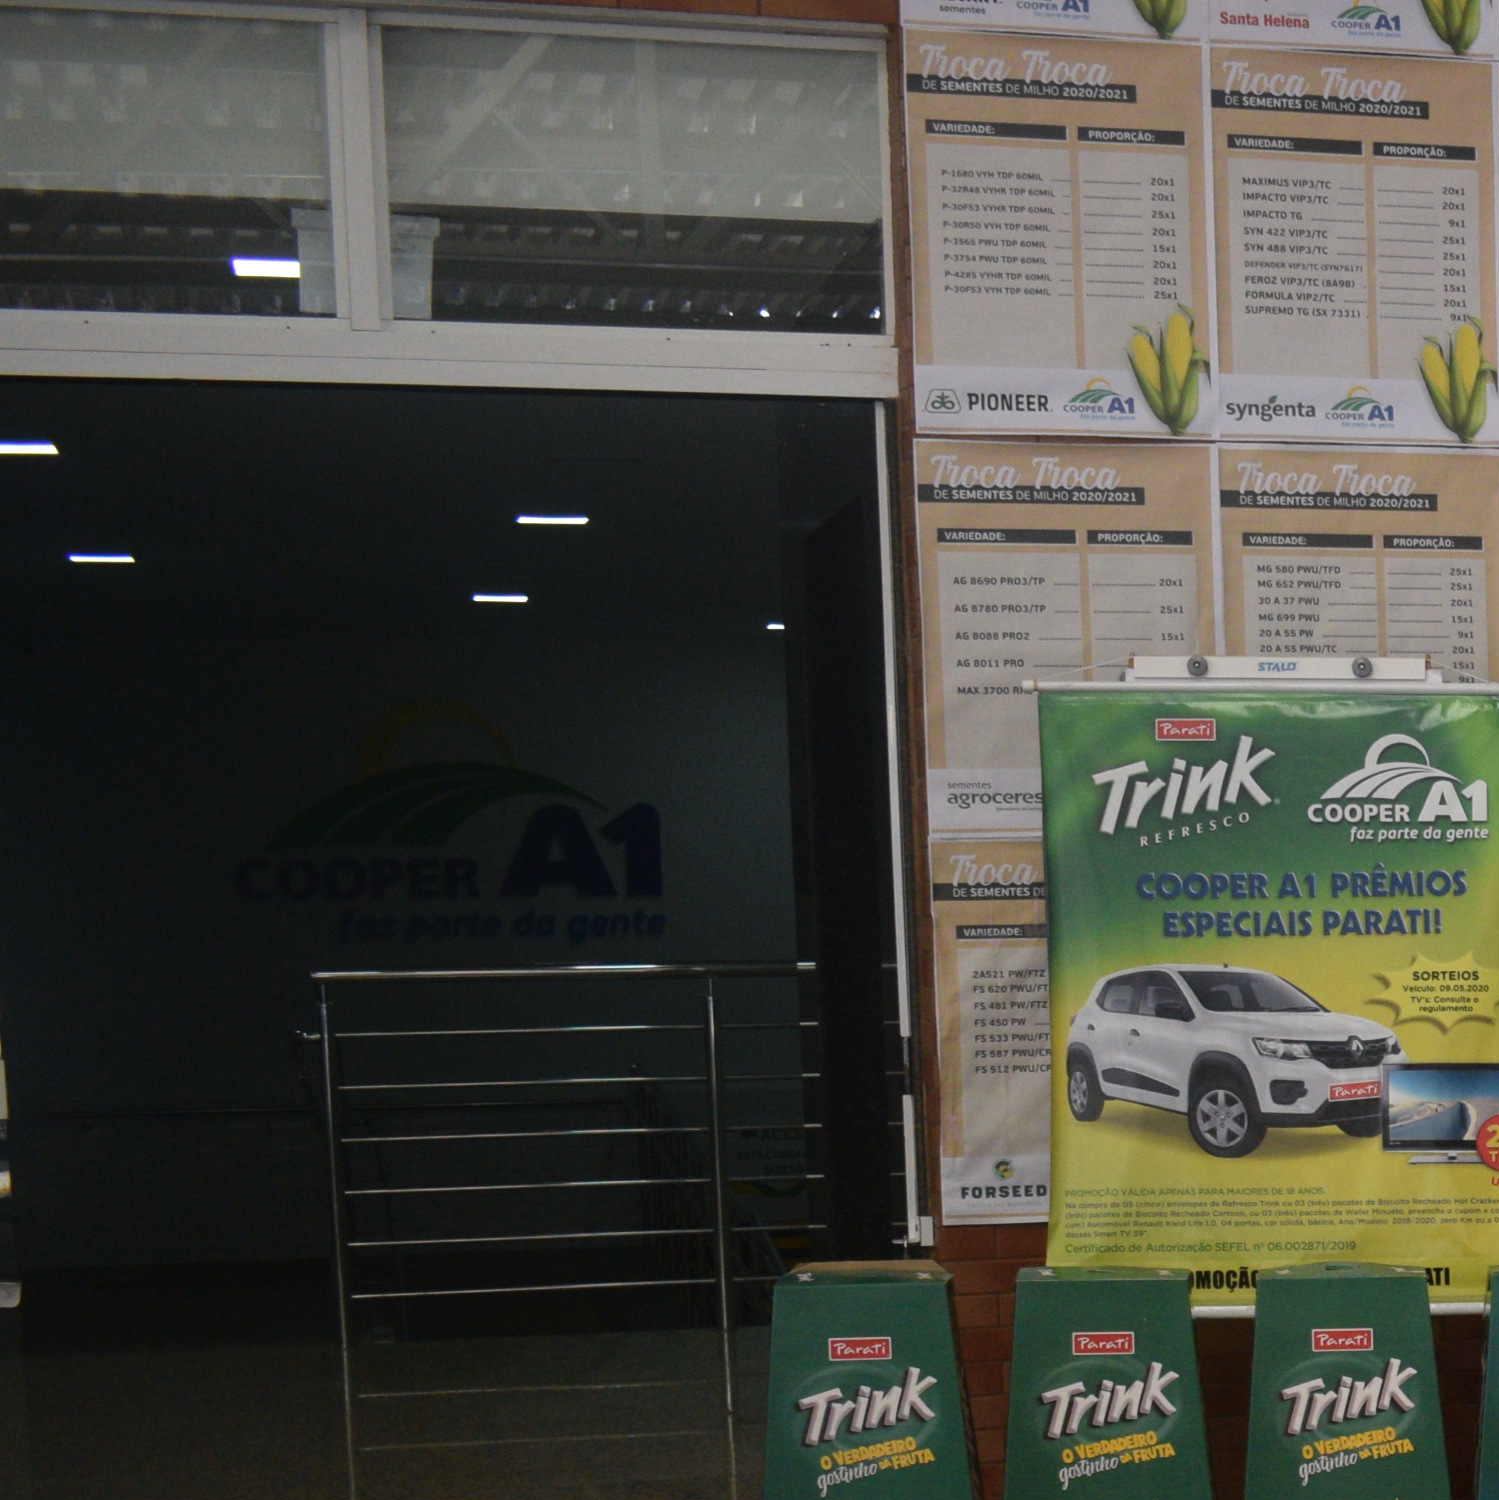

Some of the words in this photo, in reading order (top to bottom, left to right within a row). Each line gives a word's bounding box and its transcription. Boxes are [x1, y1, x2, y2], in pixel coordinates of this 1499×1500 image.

[1220, 11, 1259, 26] Santa
[1264, 14, 1309, 29] Helena
[919, 44, 1011, 81] Troca
[1022, 49, 1112, 86] Troca
[922, 80, 937, 90] DE
[940, 81, 1003, 93] SEMENTES
[1005, 84, 1020, 94] DE
[1023, 85, 1060, 96] MILHO
[1062, 87, 1128, 100] 2020/2021
[1222, 61, 1309, 97] Troca
[1321, 67, 1407, 103] Troca
[932, 123, 995, 135] VARIEDADE:
[1088, 130, 1155, 143] PROPORÇÃO:
[1243, 178, 1290, 187] MAXIMUS
[1292, 179, 1331, 190] VIP3/TC
[967, 393, 1049, 412] PIONEER
[1226, 395, 1316, 422] syngenta
[1257, 566, 1272, 574] MG
[1275, 566, 1294, 574] 580
[1297, 566, 1341, 575] PWU/TFD
[1450, 568, 1473, 576] 25x1
[971, 577, 997, 585] 8690
[1000, 577, 1045, 586] PRO3/TP
[1159, 579, 1183, 587] 20x1
[1160, 723, 1211, 736] Parati
[1092, 735, 1276, 835] Trink
[1308, 804, 1410, 822] COOPER
[1418, 780, 1487, 822] A1
[1140, 812, 1250, 847] REFRESCO
[1350, 827, 1373, 842] faz
[1378, 827, 1418, 842] parte
[1423, 827, 1441, 839] da
[1447, 827, 1489, 842] gente
[235, 857, 481, 900] COOPER
[500, 803, 663, 897] A1
[1137, 872, 1269, 899] COOPER
[1278, 872, 1317, 898] A1
[1332, 862, 1467, 898] PRÊMIOS
[1163, 910, 1312, 938] ESPECIAIS
[1323, 908, 1442, 936] PARATI!
[1413, 971, 1479, 981] SORTEIOS
[1419, 1005, 1473, 1013] regulamento
[1434, 996, 1472, 1004] Consulte
[1332, 1084, 1379, 1097] Parati
[961, 1185, 1047, 1199] FORSEED
[1159, 1188, 1196, 1196] APENAS
[1199, 1188, 1224, 1196] PARA
[1227, 1188, 1269, 1196] MAIORES
[1272, 1187, 1284, 1195] DE
[1287, 1187, 1295, 1195] 18
[1065, 1244, 1126, 1253] Certificado
[1129, 1244, 1142, 1252] de
[1147, 1244, 1212, 1254] Autorização
[1215, 1243, 1250, 1251] SEFEL
[1268, 1241, 1356, 1251] 06.002871/2019
[834, 1343, 885, 1355] Parati
[1077, 1338, 1129, 1349] Parati
[1317, 1334, 1367, 1346] Parati
[1042, 1362, 1180, 1439] Trink
[1282, 1358, 1417, 1434] Trink
[799, 1366, 937, 1445] Trink
[1075, 1431, 1157, 1459] VERDADEIRO
[1315, 1426, 1396, 1455] VERDADEIRO
[1372, 1439, 1414, 1459] FRUTA
[834, 1437, 916, 1465] VERDADEIRO
[892, 1449, 935, 1469] FRUTA
[1133, 1443, 1176, 1463] FRUTA
